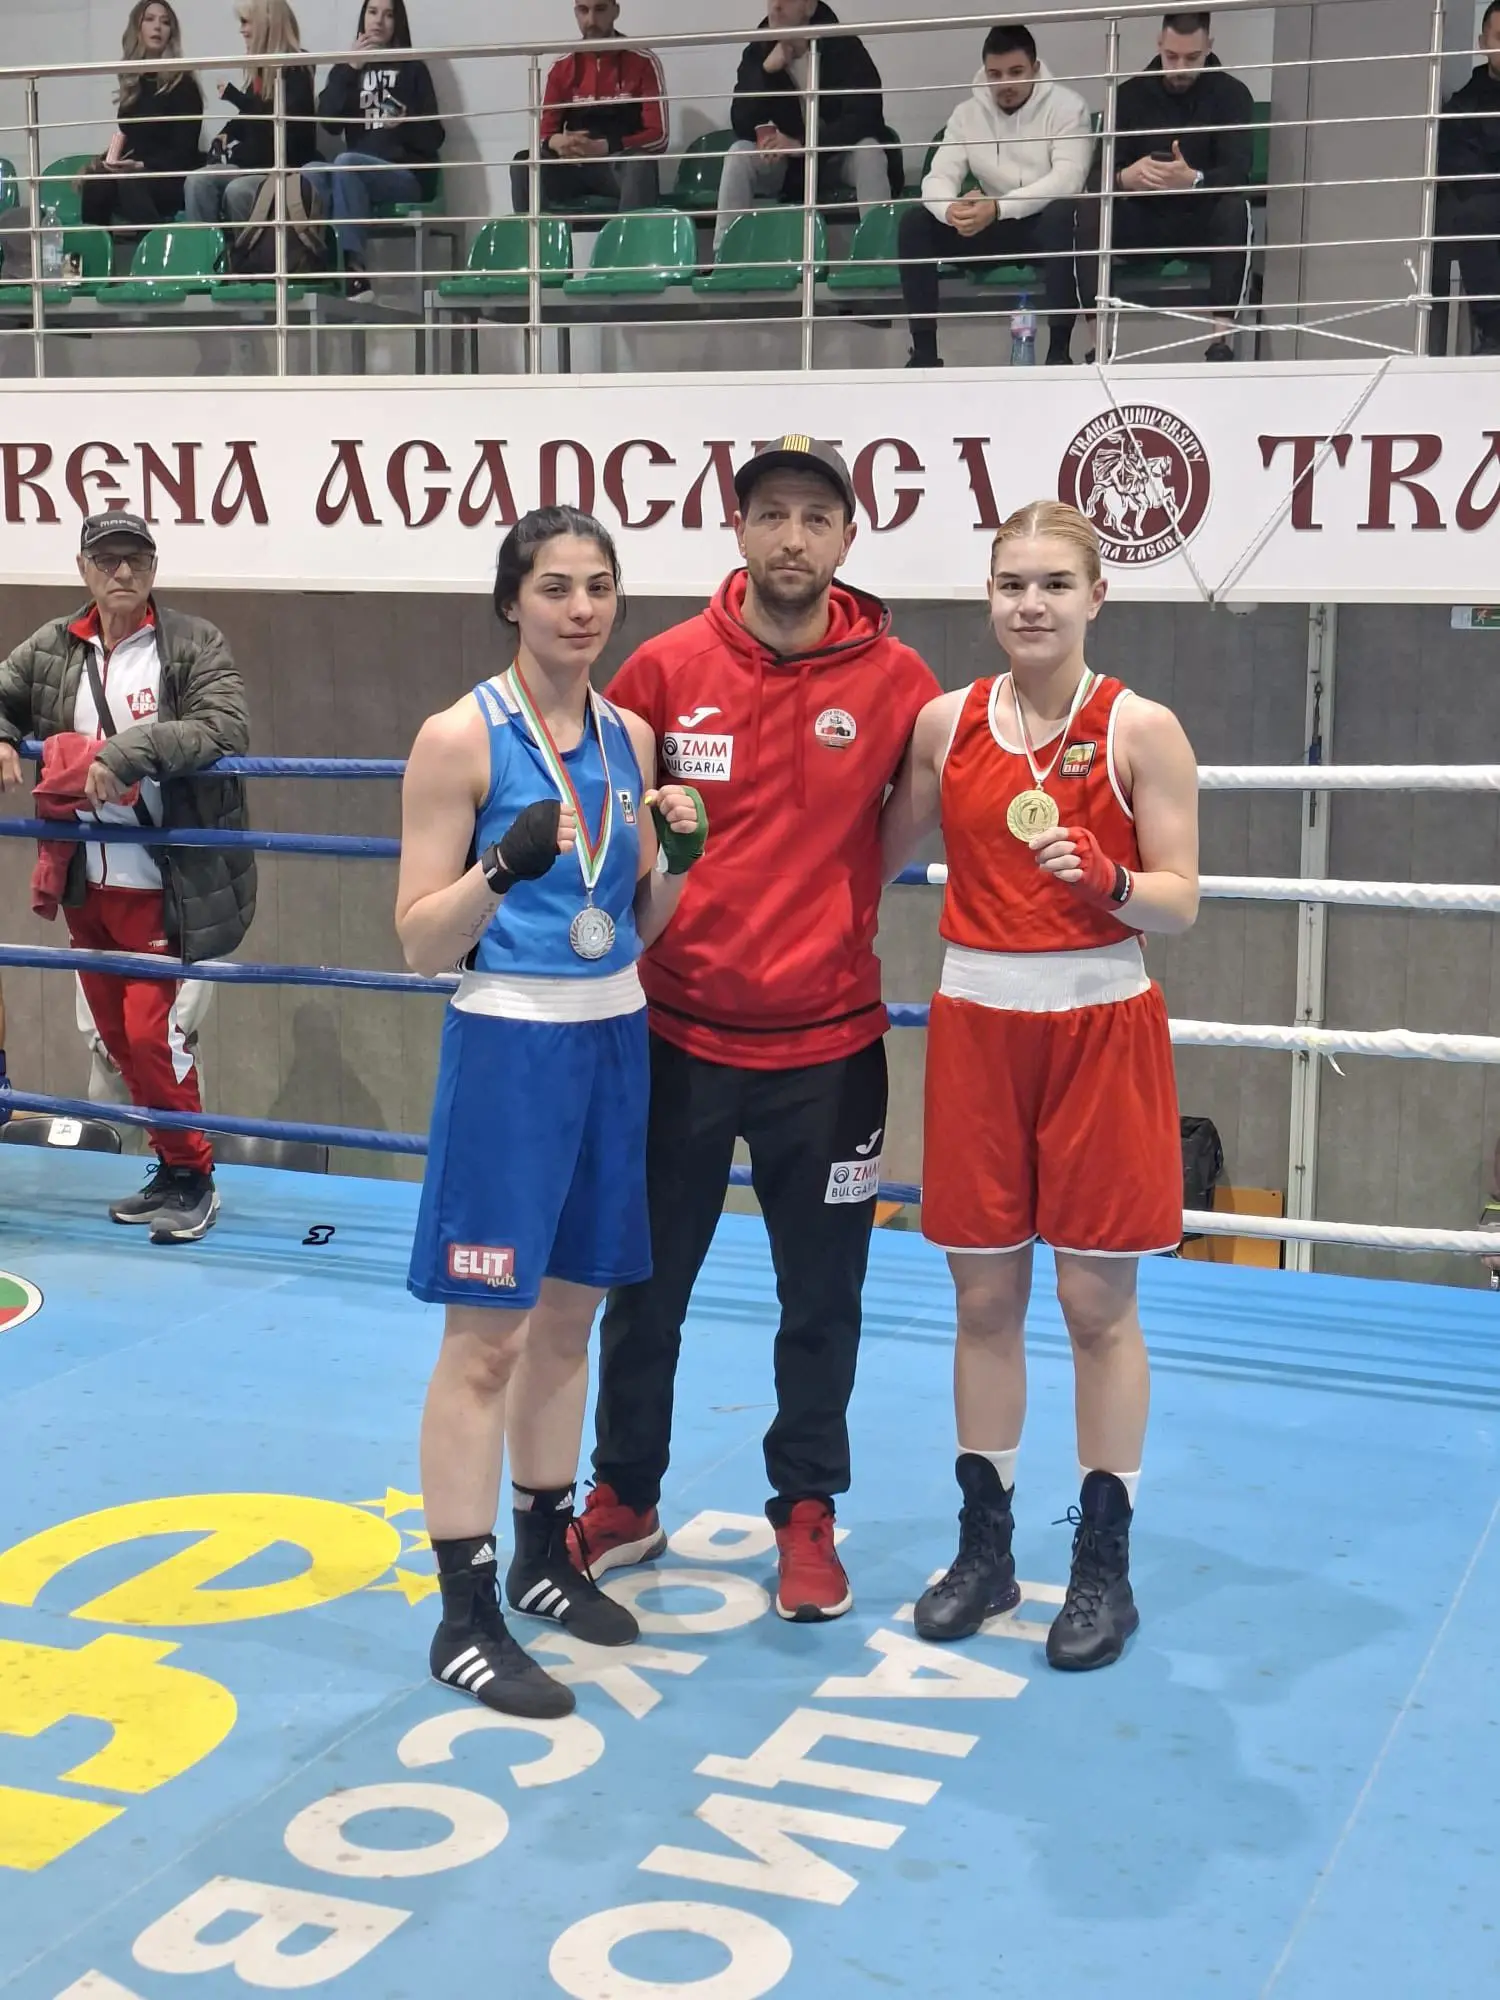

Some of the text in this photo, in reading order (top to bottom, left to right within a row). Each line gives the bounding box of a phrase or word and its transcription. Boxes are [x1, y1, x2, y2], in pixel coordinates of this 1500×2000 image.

[1069, 407, 1205, 463] TRAKIA UNIVERSITY
[0, 440, 269, 525] RENA
[682, 739, 727, 757] ZMM
[486, 1272, 517, 1288] nuts
[52, 1509, 852, 2000] БОКСОВ
